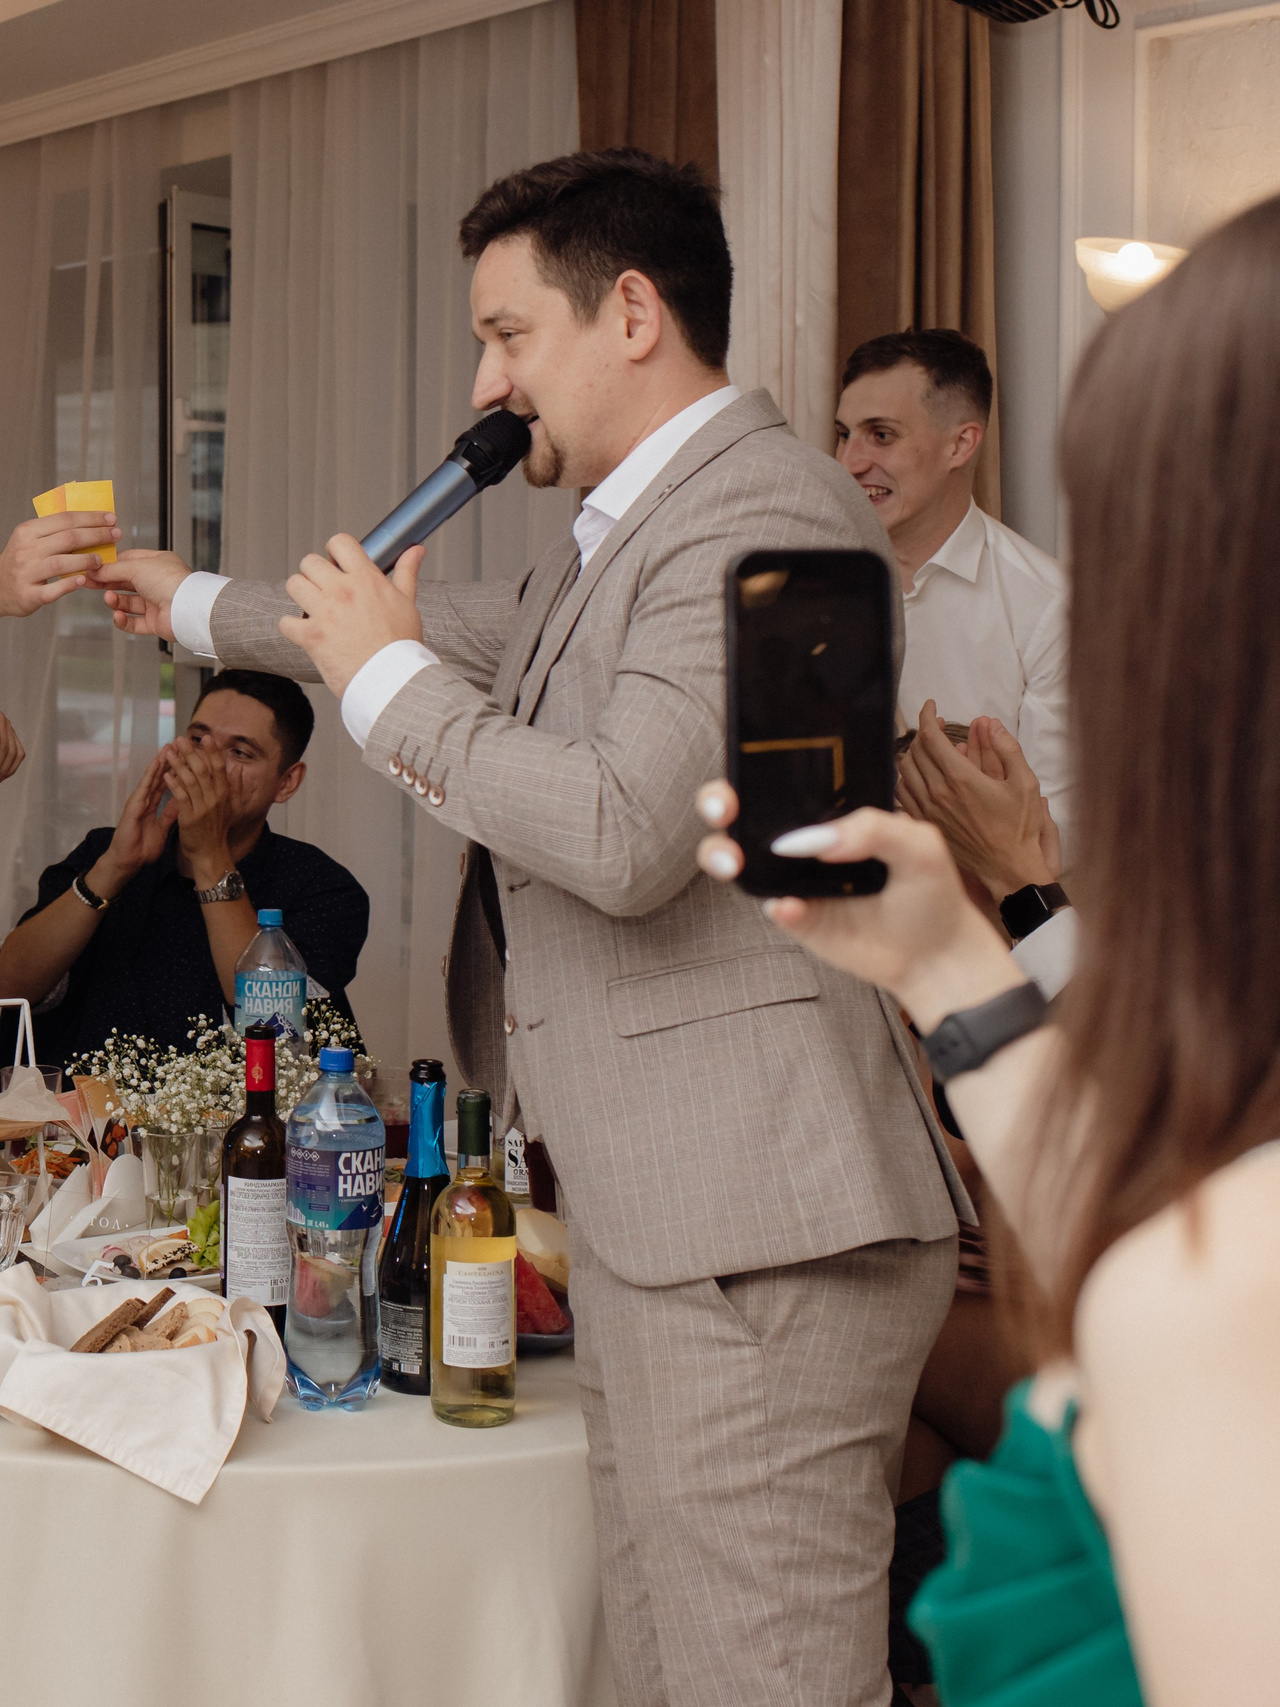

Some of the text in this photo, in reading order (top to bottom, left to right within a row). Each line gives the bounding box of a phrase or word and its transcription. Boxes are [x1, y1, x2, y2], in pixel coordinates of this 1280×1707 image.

[244, 980, 300, 998] СКАНДИ
[244, 997, 294, 1014] НАВИЯ
[338, 1147, 382, 1174] СКАН
